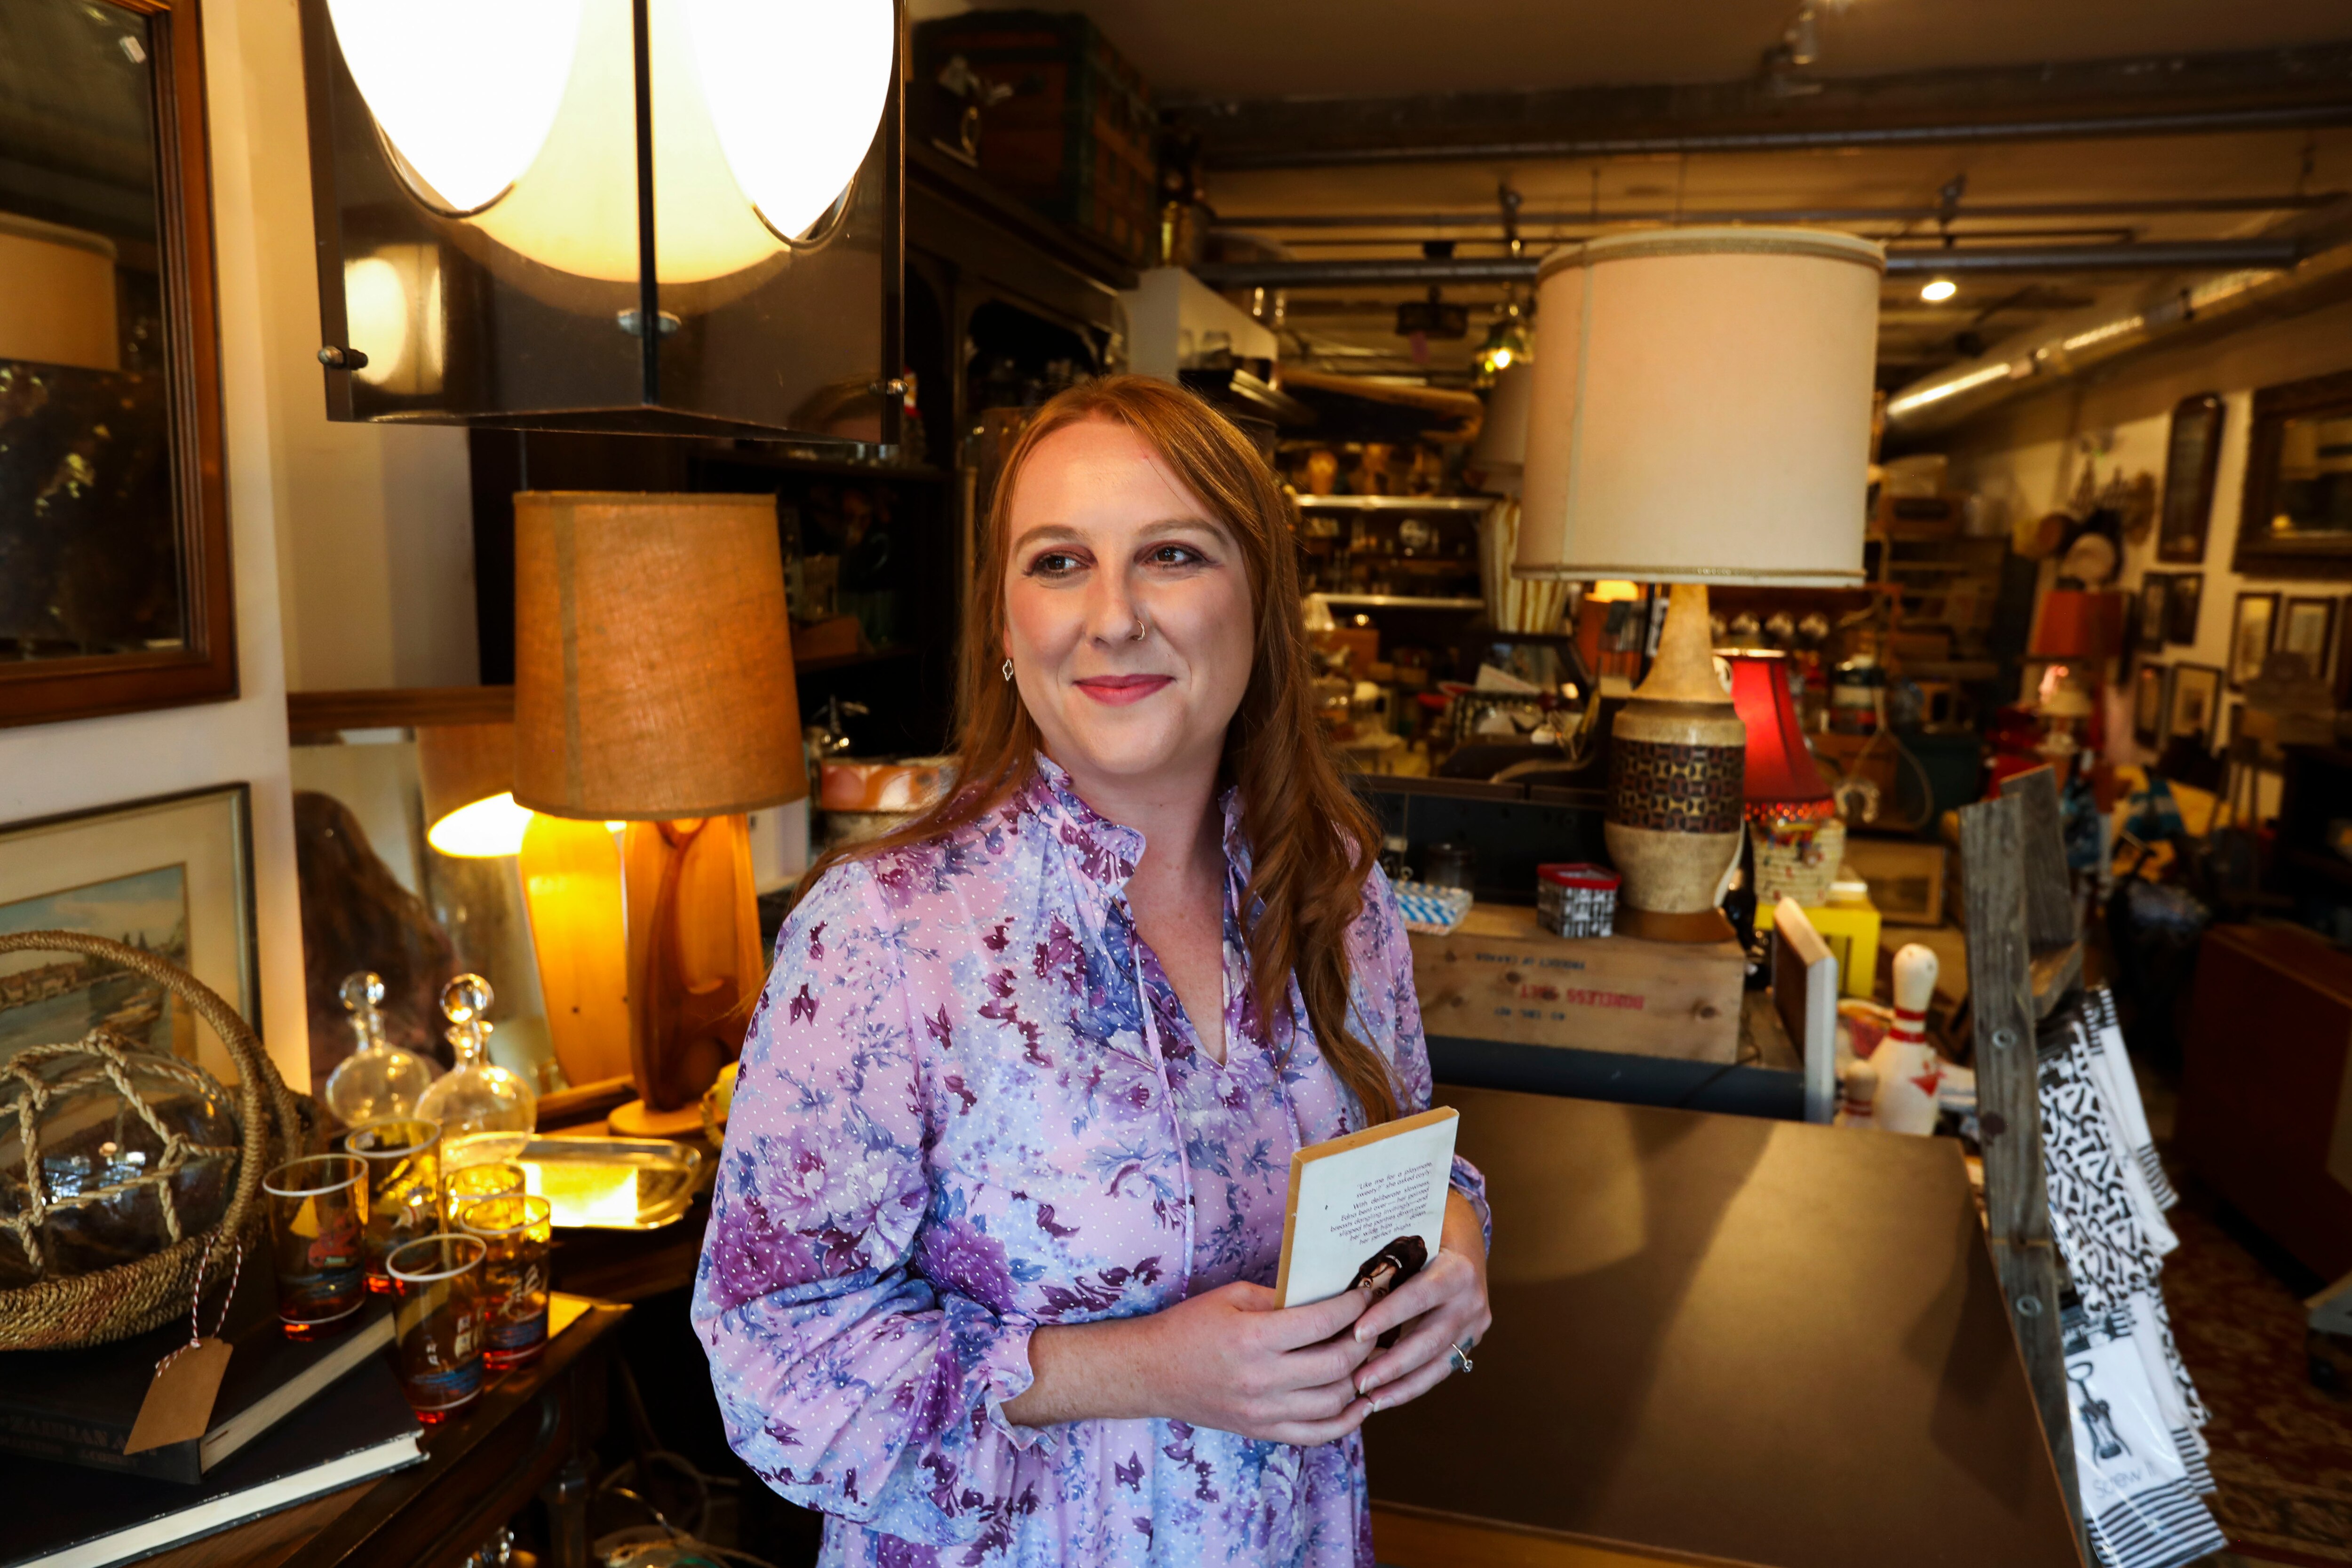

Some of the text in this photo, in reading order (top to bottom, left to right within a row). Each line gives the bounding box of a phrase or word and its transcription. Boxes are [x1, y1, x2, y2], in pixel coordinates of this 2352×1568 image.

[1397, 1174, 1414, 1185] asked
[1353, 1180, 1430, 1209] With deliberate slowness
[1359, 1207, 1372, 1215] bent
[1408, 1186, 1429, 1200] pointed
[1330, 1222, 1352, 1232] breasts
[1354, 1212, 1382, 1224] dangling
[1339, 1224, 1361, 1237] slipped
[1374, 1215, 1395, 1226] panties
[1397, 1209, 1413, 1218] down
[1363, 1227, 1378, 1236] wide
[1410, 1210, 1426, 1219] down
[1371, 1229, 1391, 1242] perfect
